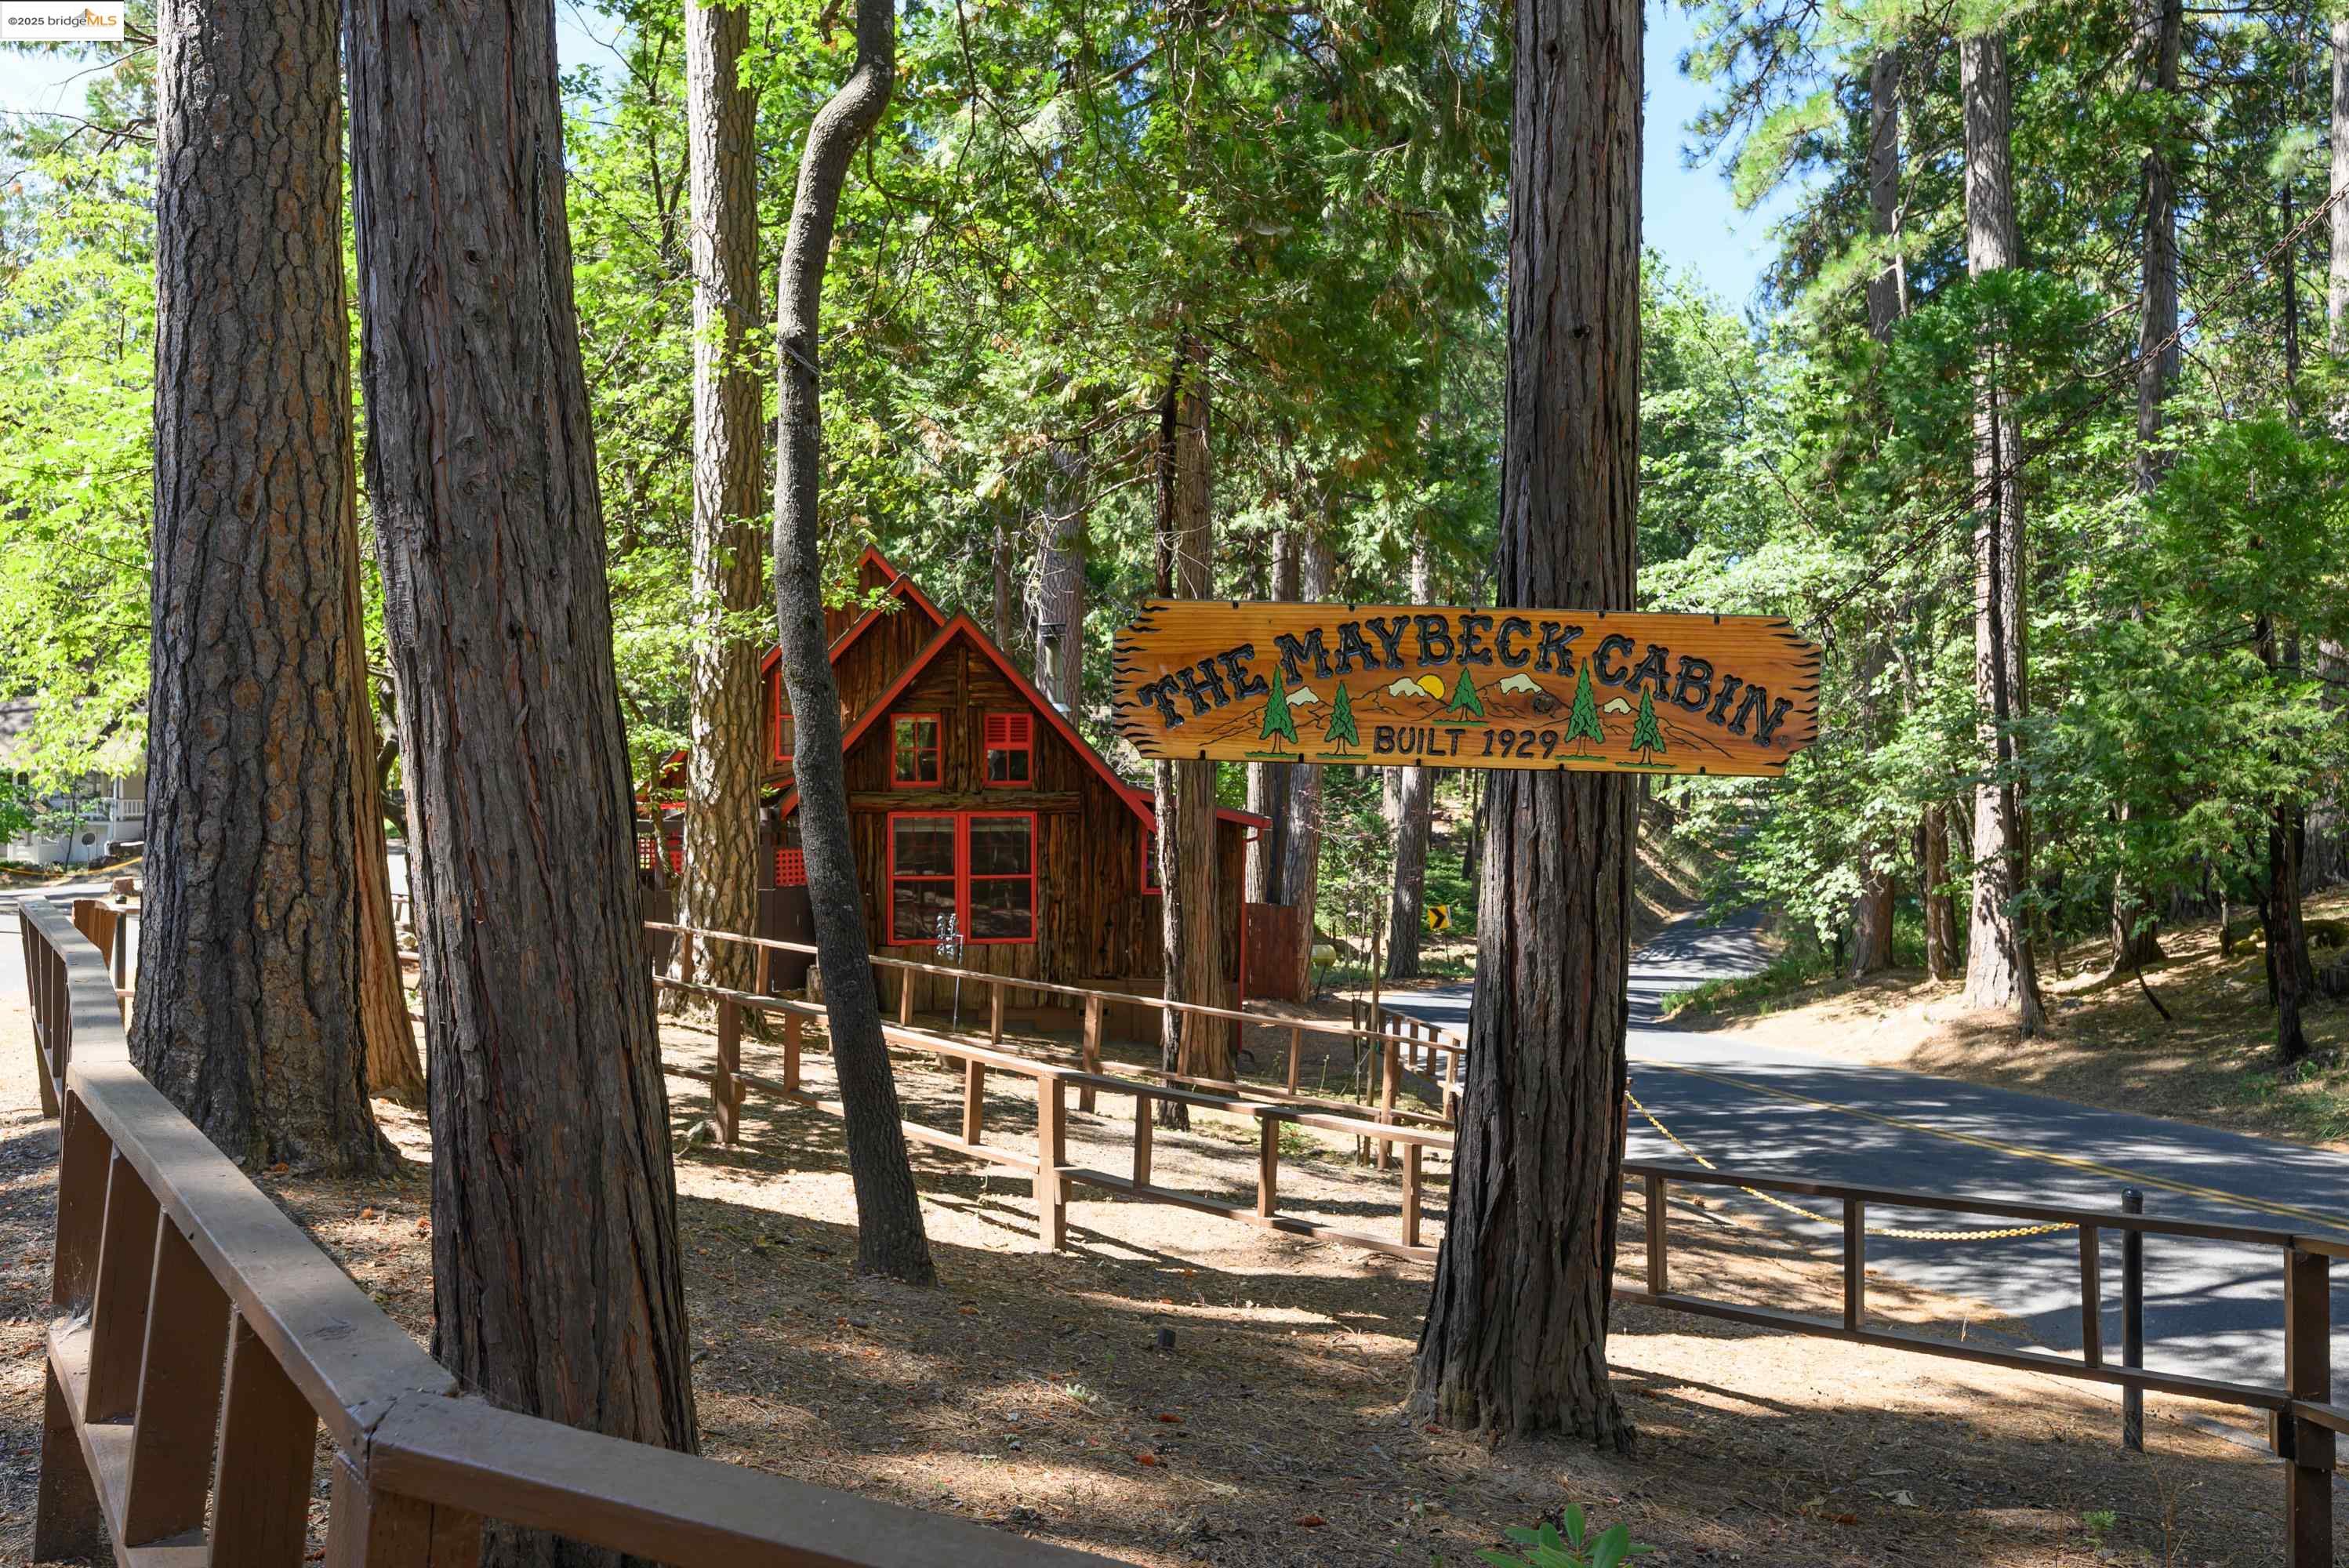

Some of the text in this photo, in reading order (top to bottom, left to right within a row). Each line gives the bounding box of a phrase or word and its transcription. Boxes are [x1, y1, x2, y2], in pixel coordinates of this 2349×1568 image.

[1136, 614, 1795, 748] THE MAYBECK CABIN
[1373, 724, 1559, 760] BUILT 1929
